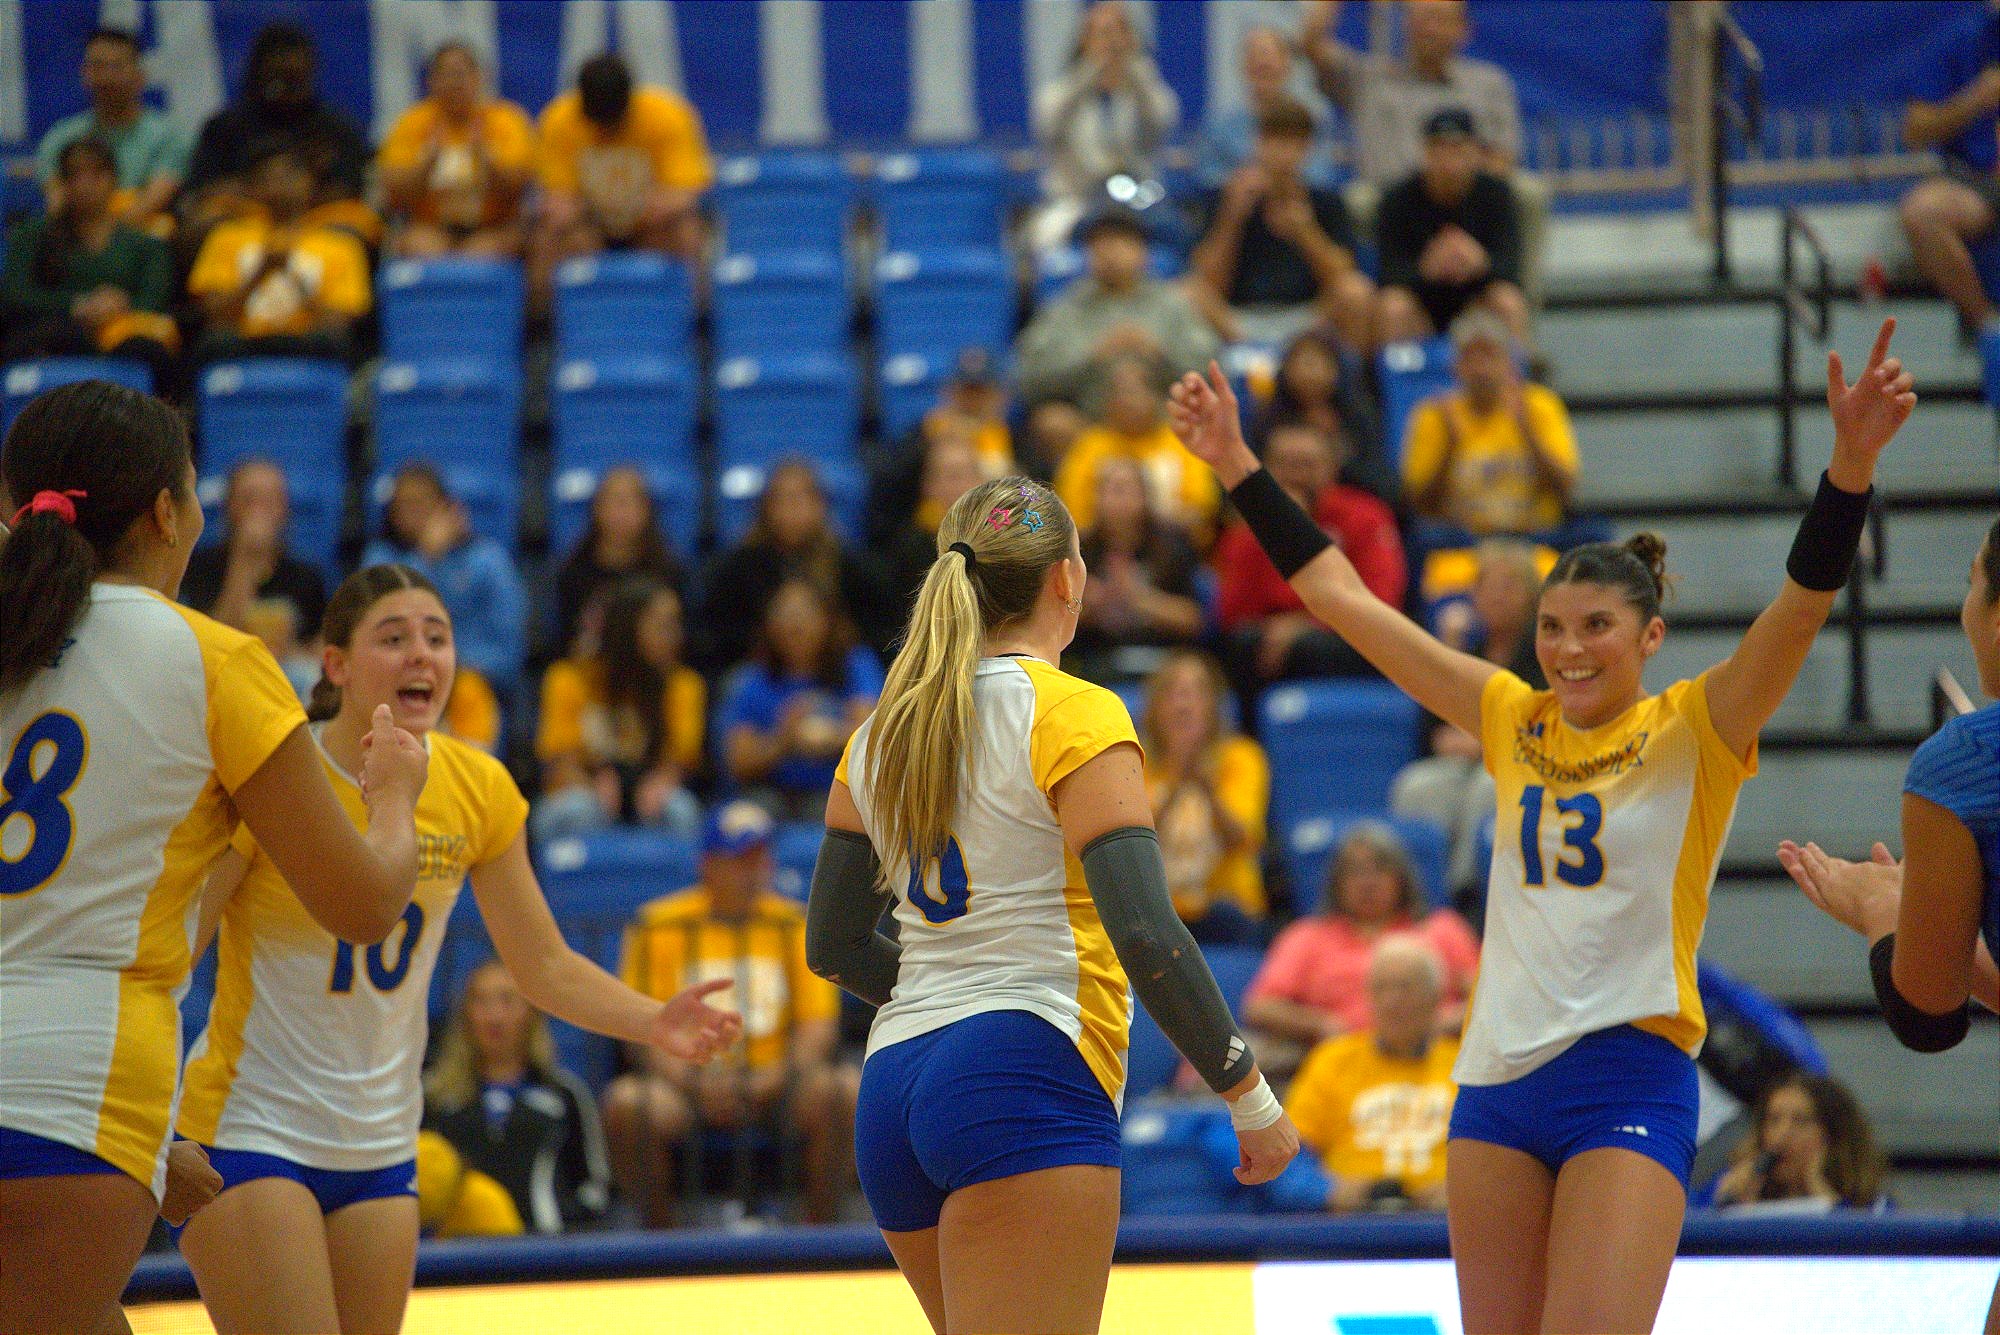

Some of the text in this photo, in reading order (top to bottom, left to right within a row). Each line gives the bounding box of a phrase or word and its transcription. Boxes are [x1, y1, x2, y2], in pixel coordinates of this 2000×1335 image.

[0, 706, 91, 899] 8
[1518, 783, 1607, 890] 13
[326, 900, 428, 995] 10
